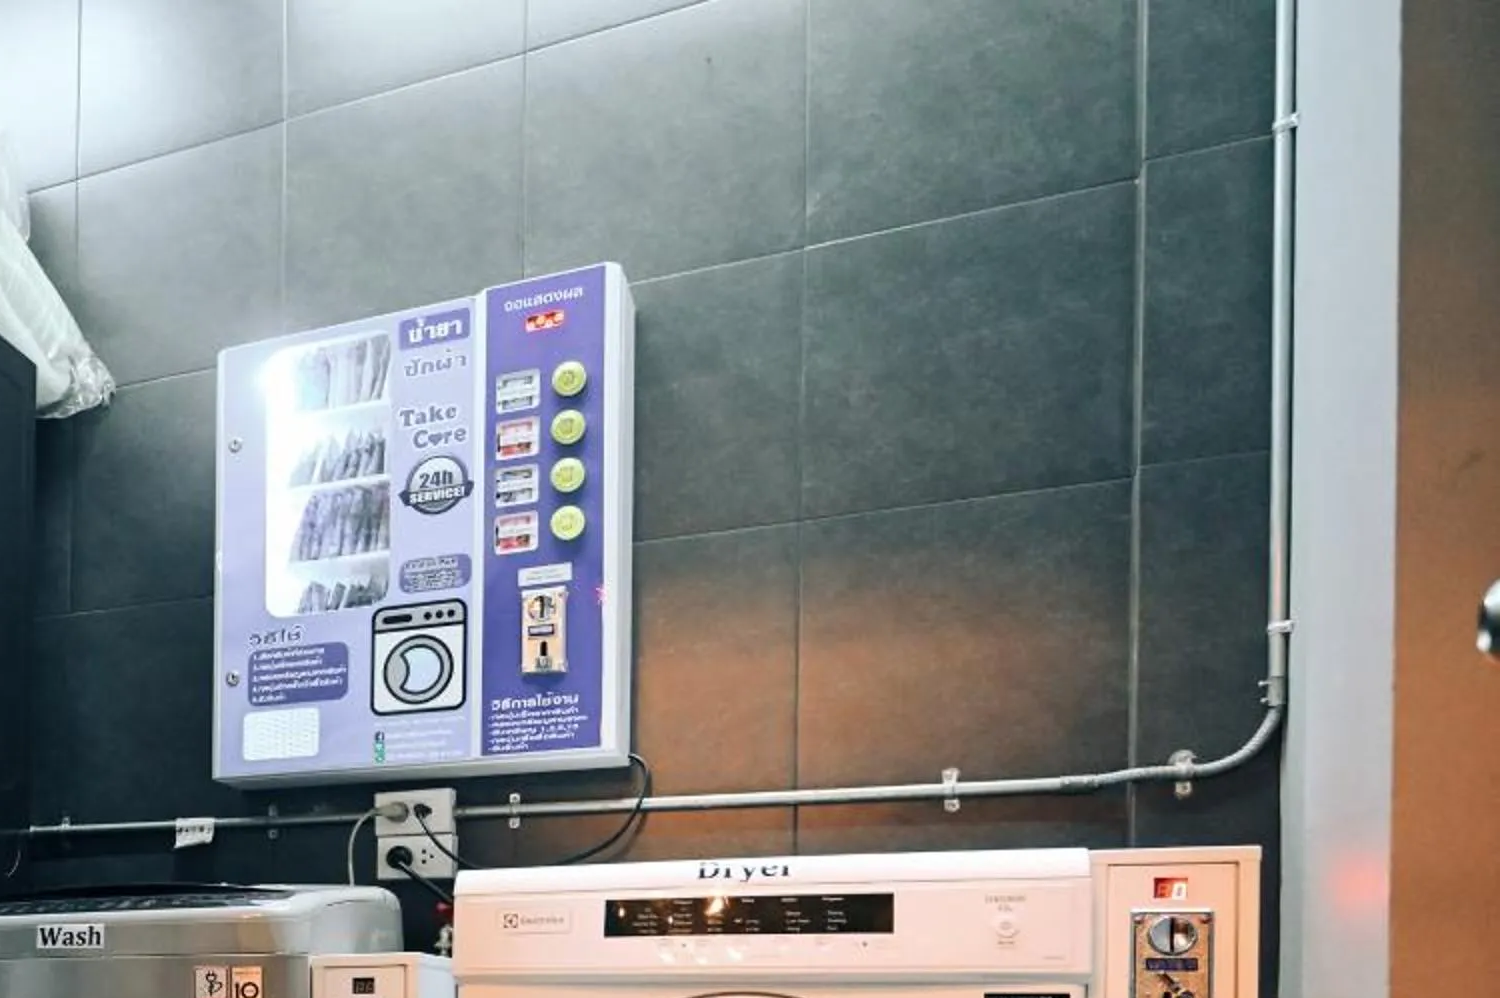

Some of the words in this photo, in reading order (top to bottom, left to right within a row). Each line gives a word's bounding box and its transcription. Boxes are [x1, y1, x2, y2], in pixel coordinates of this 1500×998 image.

[409, 318, 462, 343] น้ำยา
[403, 347, 467, 377] ซักผ้า
[399, 405, 457, 427] Take
[419, 470, 453, 490] 24h
[39, 925, 101, 946] Wash
